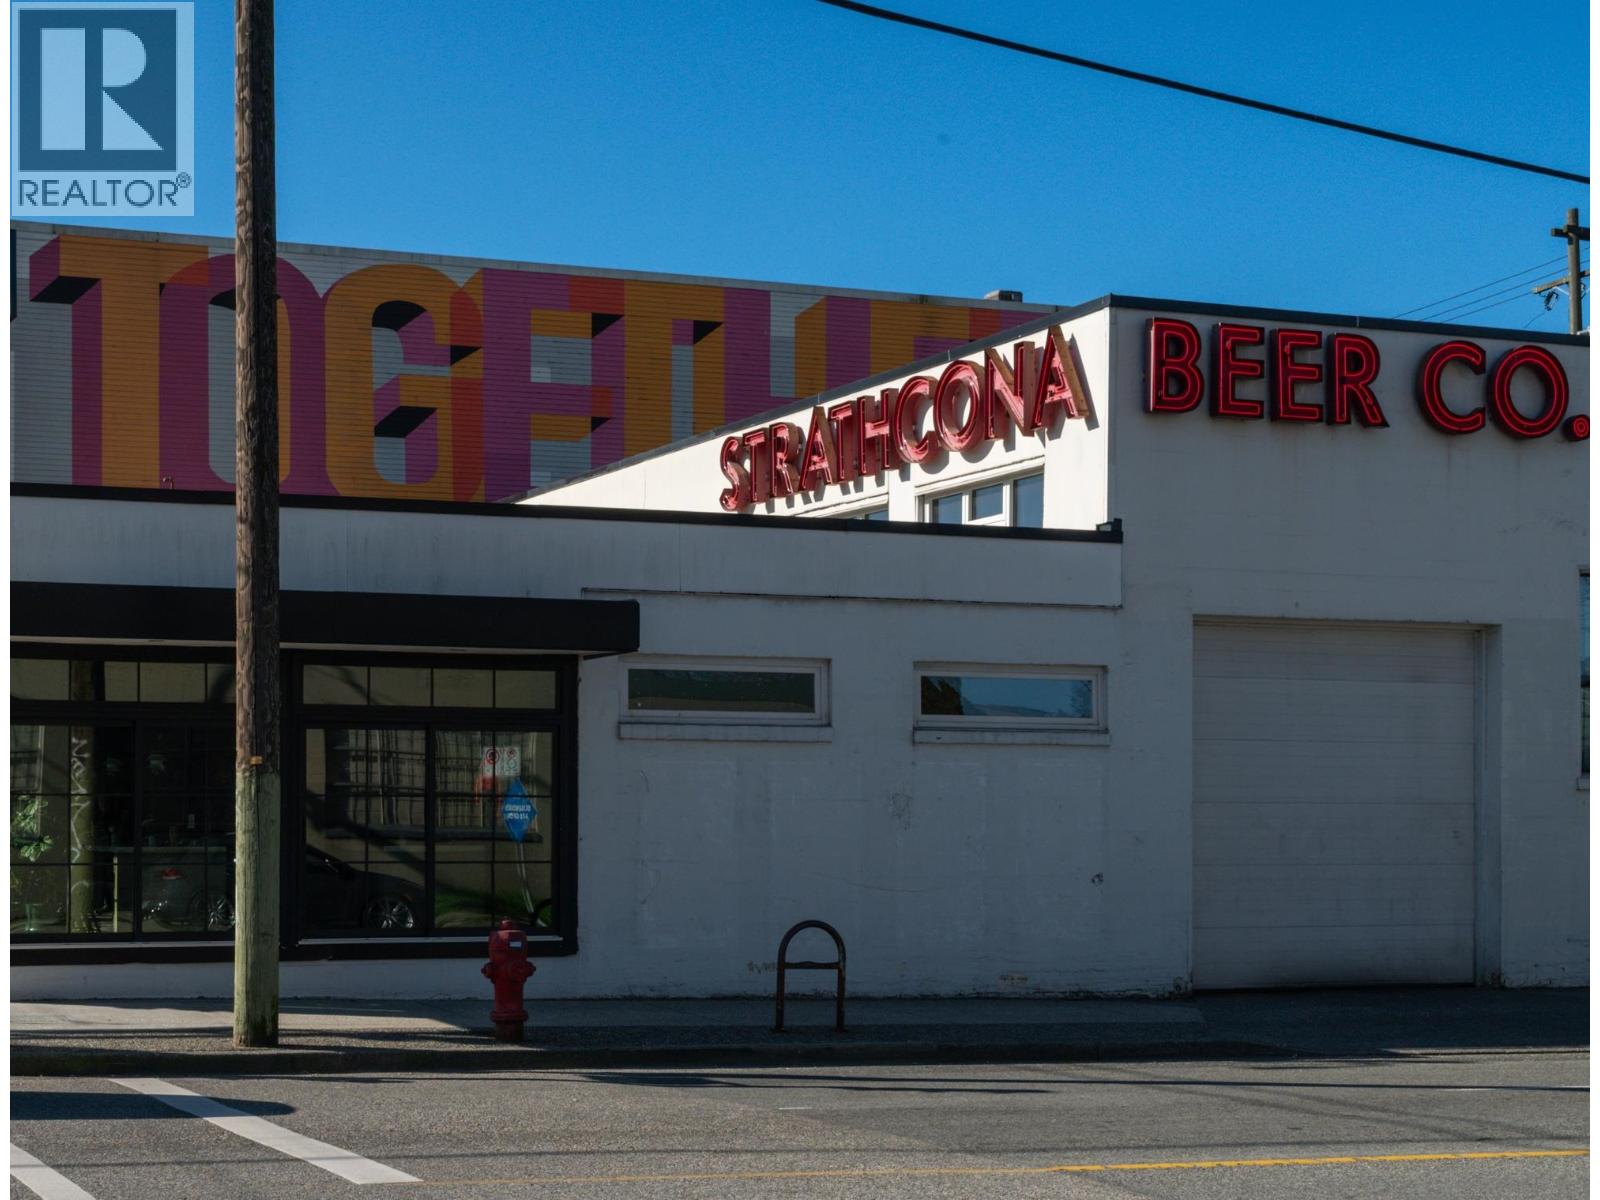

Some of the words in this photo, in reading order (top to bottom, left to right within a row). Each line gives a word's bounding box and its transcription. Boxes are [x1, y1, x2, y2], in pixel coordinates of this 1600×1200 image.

[29, 234, 1050, 504] TOGETH
[719, 325, 1092, 512] STRATHCONA
[1144, 316, 1389, 428] BEER
[1416, 340, 1590, 441] CO.
